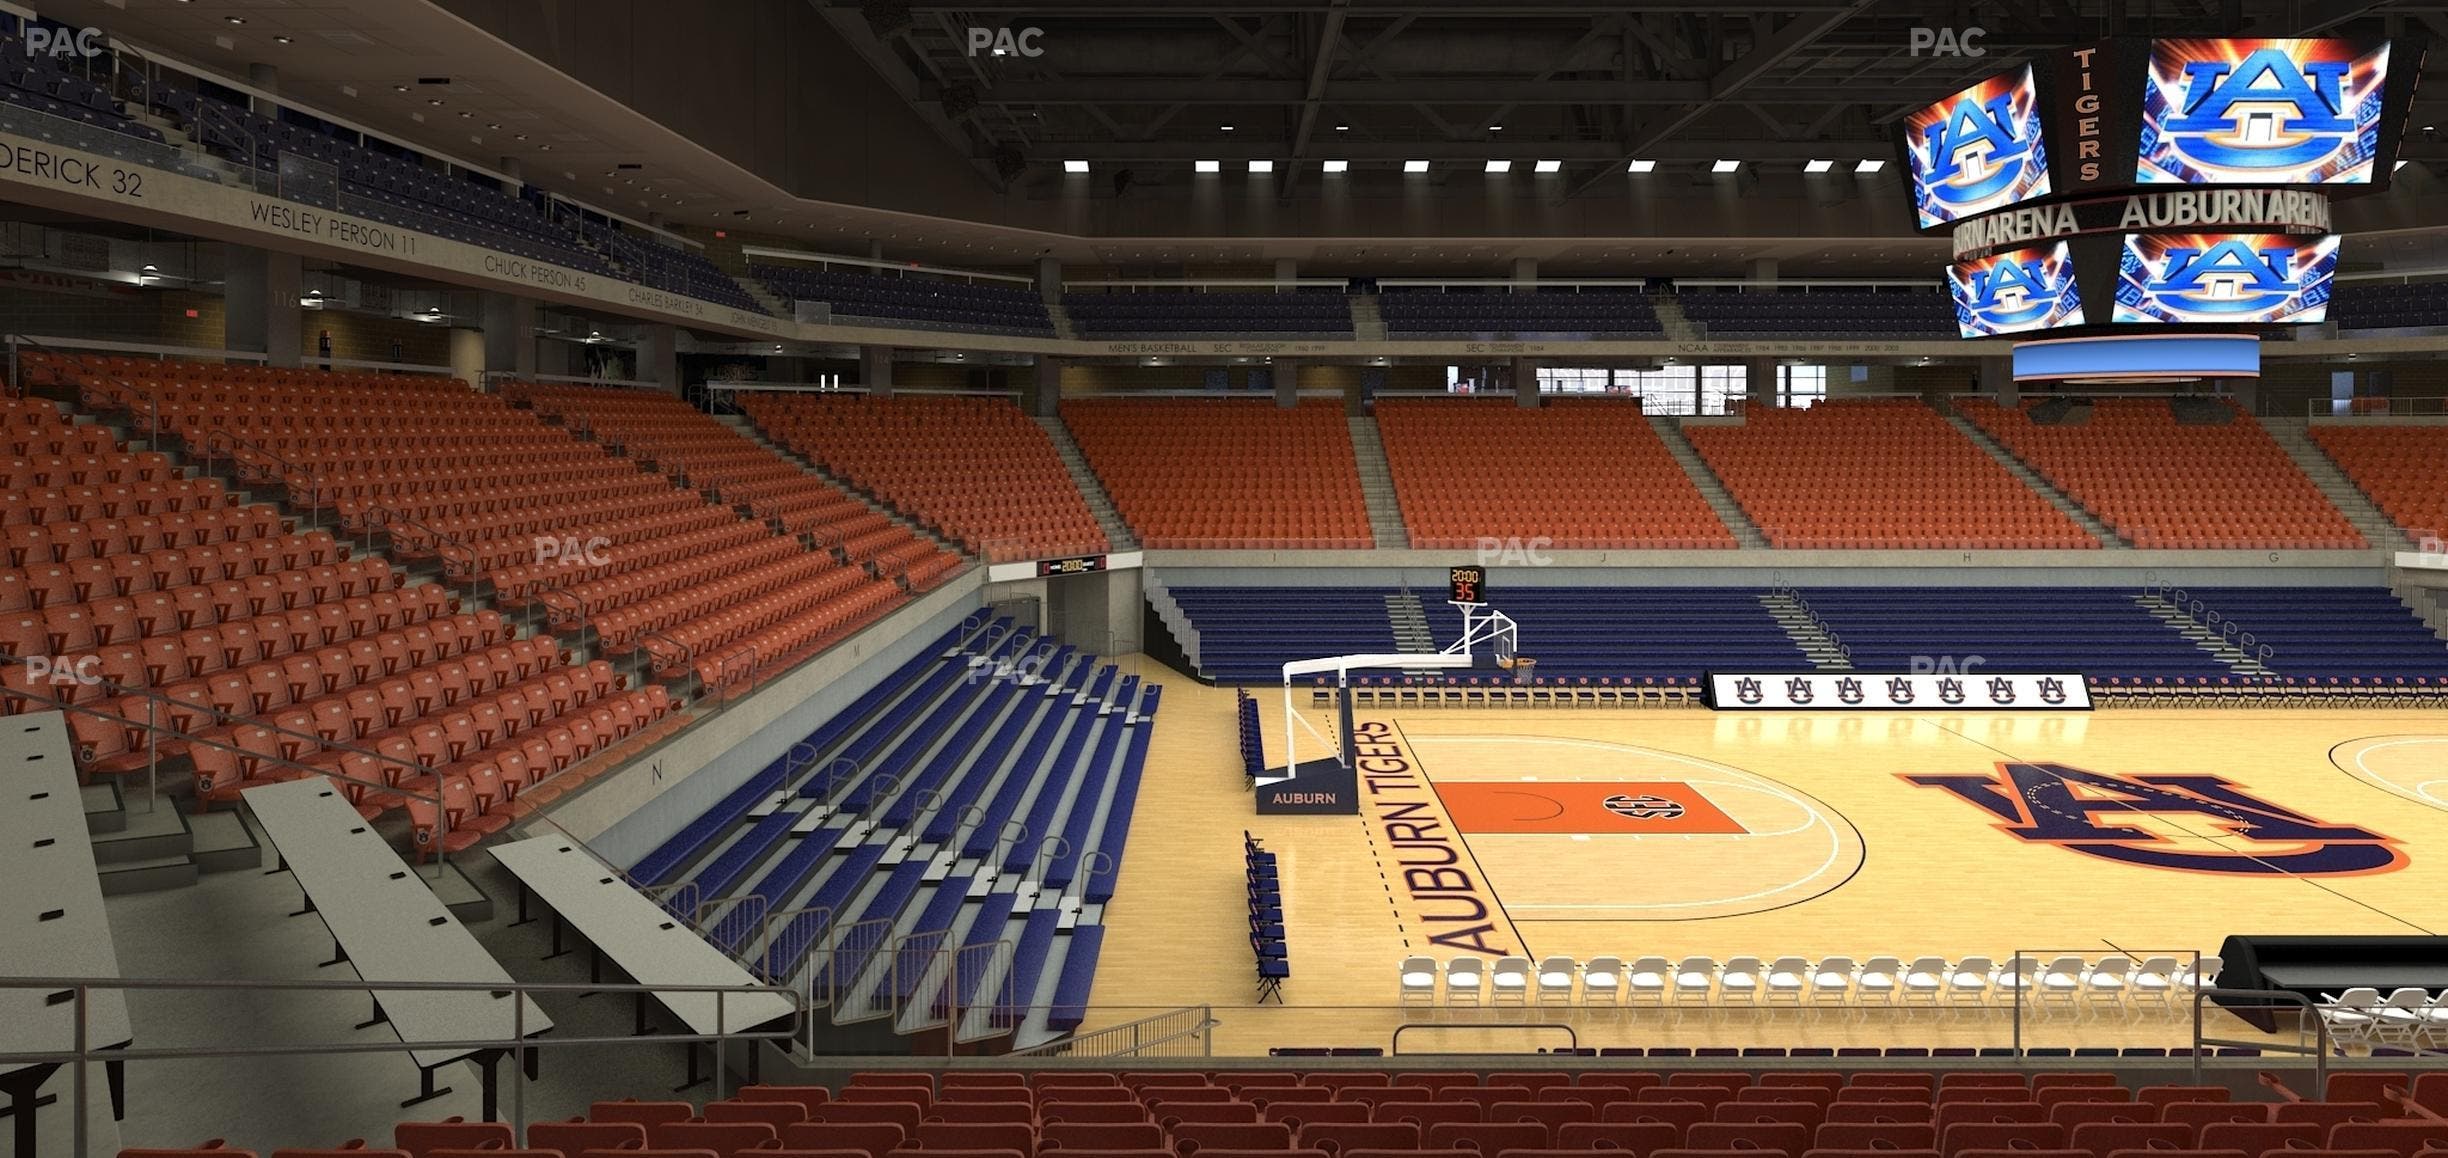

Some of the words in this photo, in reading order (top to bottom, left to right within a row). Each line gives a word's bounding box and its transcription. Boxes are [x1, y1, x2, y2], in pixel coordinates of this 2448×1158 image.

[2073, 48, 2101, 181] TIGERS
[112, 169, 142, 198] 32
[2119, 188, 2264, 229] AUBURN
[2265, 189, 2329, 231] ARENA
[250, 200, 322, 234] WESLEY
[329, 219, 395, 250] PERSON
[402, 235, 416, 255] 11
[1986, 203, 2080, 246] ARENA
[484, 255, 528, 279] CHUCK
[531, 265, 572, 288] PERSON
[574, 276, 586, 291] 45
[628, 287, 663, 308] CHARLES
[665, 296, 694, 314] BARKLEY
[1108, 343, 1138, 352] MEN'S
[1140, 343, 1198, 352] BASKETBALL
[1213, 343, 1232, 352] SEC
[1466, 343, 1485, 352] SEC
[1678, 344, 1709, 352] NCAA
[1062, 559, 1083, 572] 20:00
[1963, 552, 1971, 563] H
[2268, 552, 2279, 563] G
[1451, 569, 1479, 583] 20:00
[1455, 582, 1474, 601] 35
[1353, 720, 1421, 795] TIGERS
[652, 760, 662, 785] N
[1272, 792, 1336, 804] AUBURN
[1374, 801, 1511, 957] AUBURN
